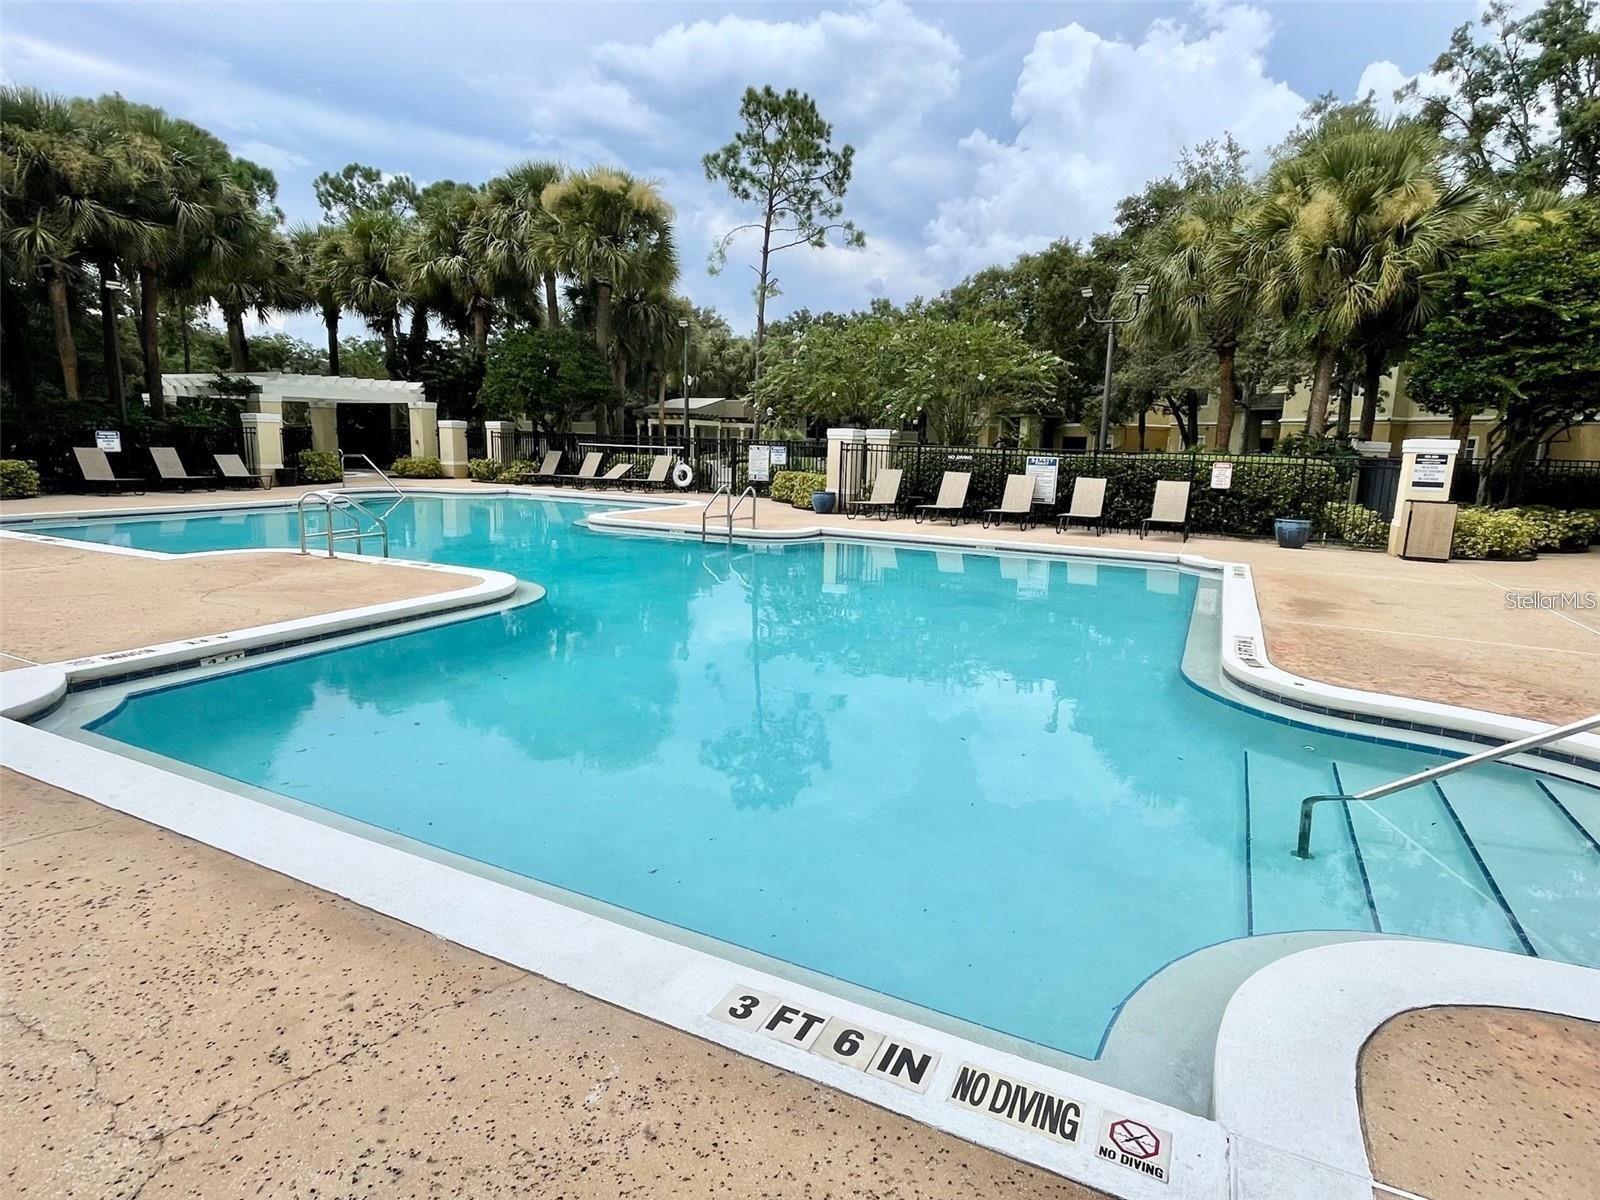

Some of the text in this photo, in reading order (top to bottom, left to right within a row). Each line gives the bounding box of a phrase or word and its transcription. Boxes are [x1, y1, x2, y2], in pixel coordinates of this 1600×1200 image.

[728, 994, 932, 1084] 3 FT 6 IN
[951, 1066, 1081, 1143] NO DIVING
[1098, 1145, 1164, 1179] NO DIVING
